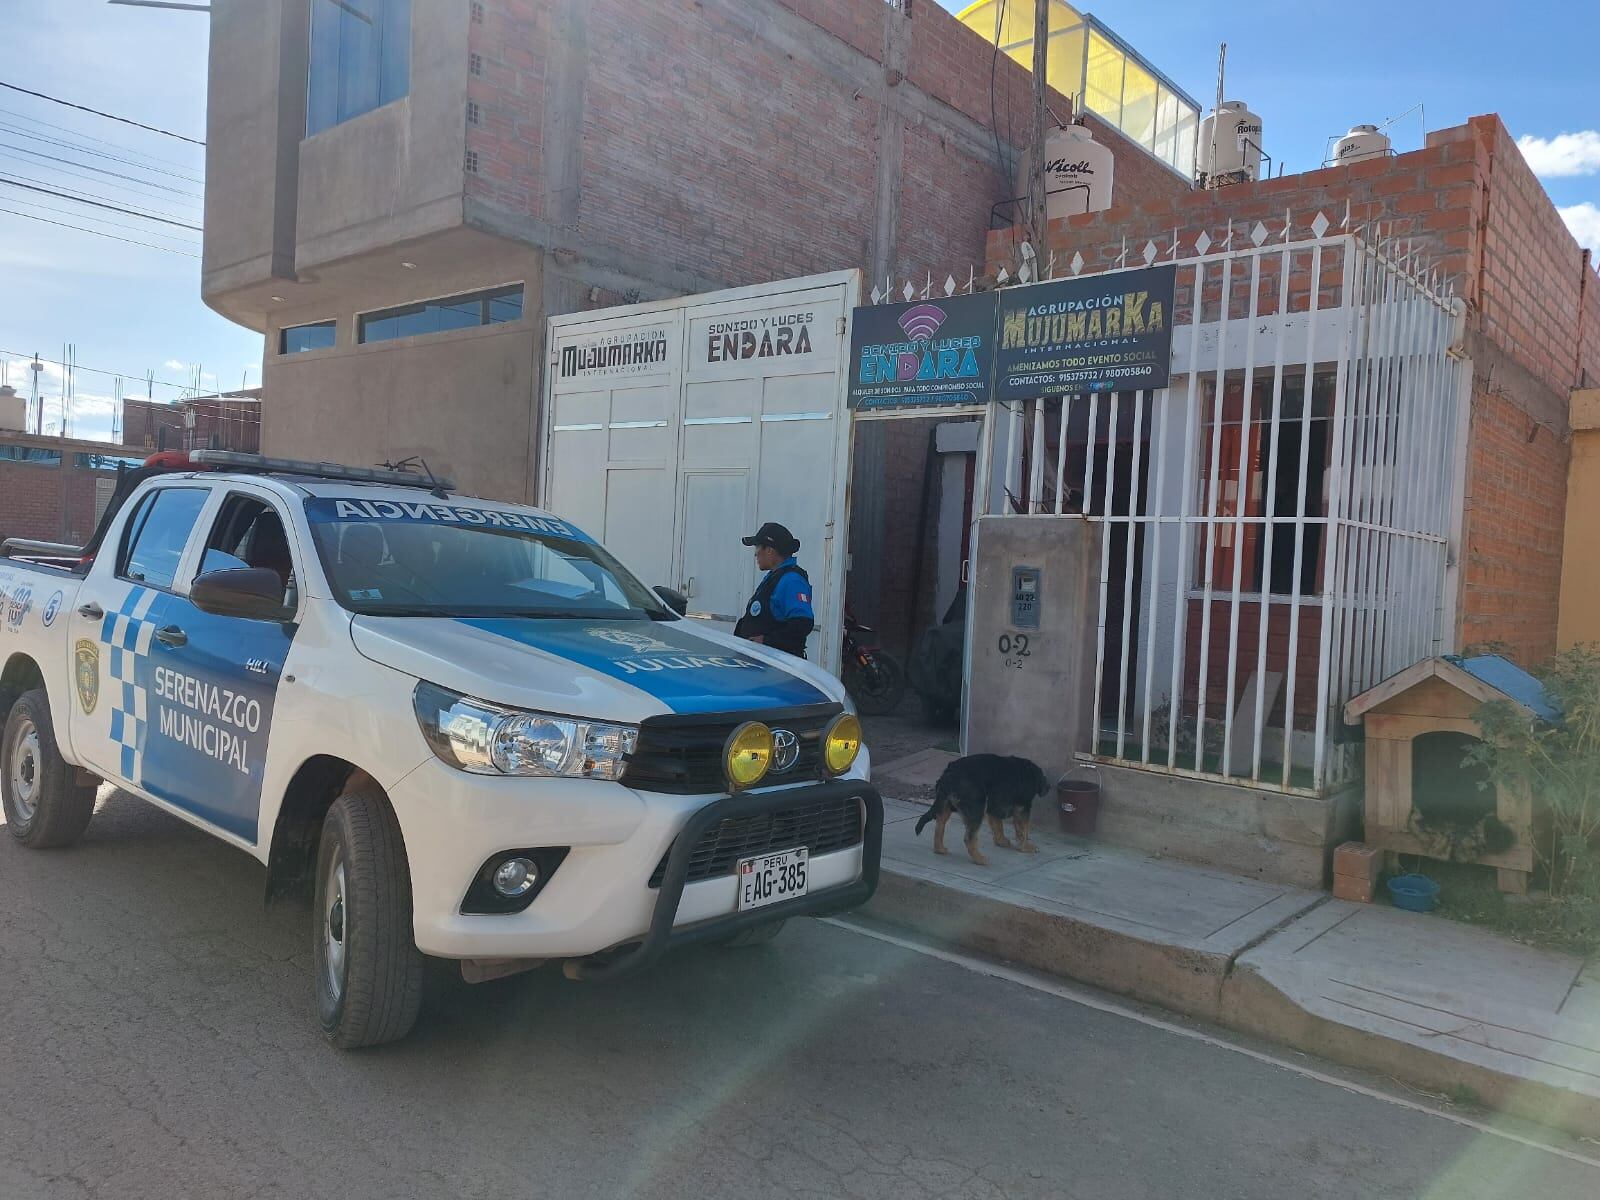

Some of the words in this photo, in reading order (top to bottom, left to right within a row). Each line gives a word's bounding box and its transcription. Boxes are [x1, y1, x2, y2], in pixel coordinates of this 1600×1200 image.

[1028, 294, 1123, 316] AGRUPACIÓN
[709, 320, 757, 334] SONIDO
[761, 318, 768, 327] Y
[772, 313, 813, 326] LUCES
[708, 325, 812, 362] ENDARA
[1025, 337, 1138, 353] INTERNACIONAL
[860, 347, 979, 384] ENDARA
[1007, 359, 1060, 372] AMENIZAMOS
[1062, 357, 1086, 367] TODO
[1088, 353, 1121, 365] EVENTO
[1123, 351, 1156, 361] SOCIAL
[1009, 375, 1055, 386] CONTACTOS:
[1059, 370, 1097, 381] 915375732
[1105, 366, 1152, 378] 980705840
[916, 384, 930, 392] TODO
[45, 600, 58, 621] 5
[613, 657, 764, 674] JULIACA
[155, 666, 261, 732] SERENAZGO
[160, 705, 249, 774] MUNICIPAL
[764, 856, 787, 869] PERU
